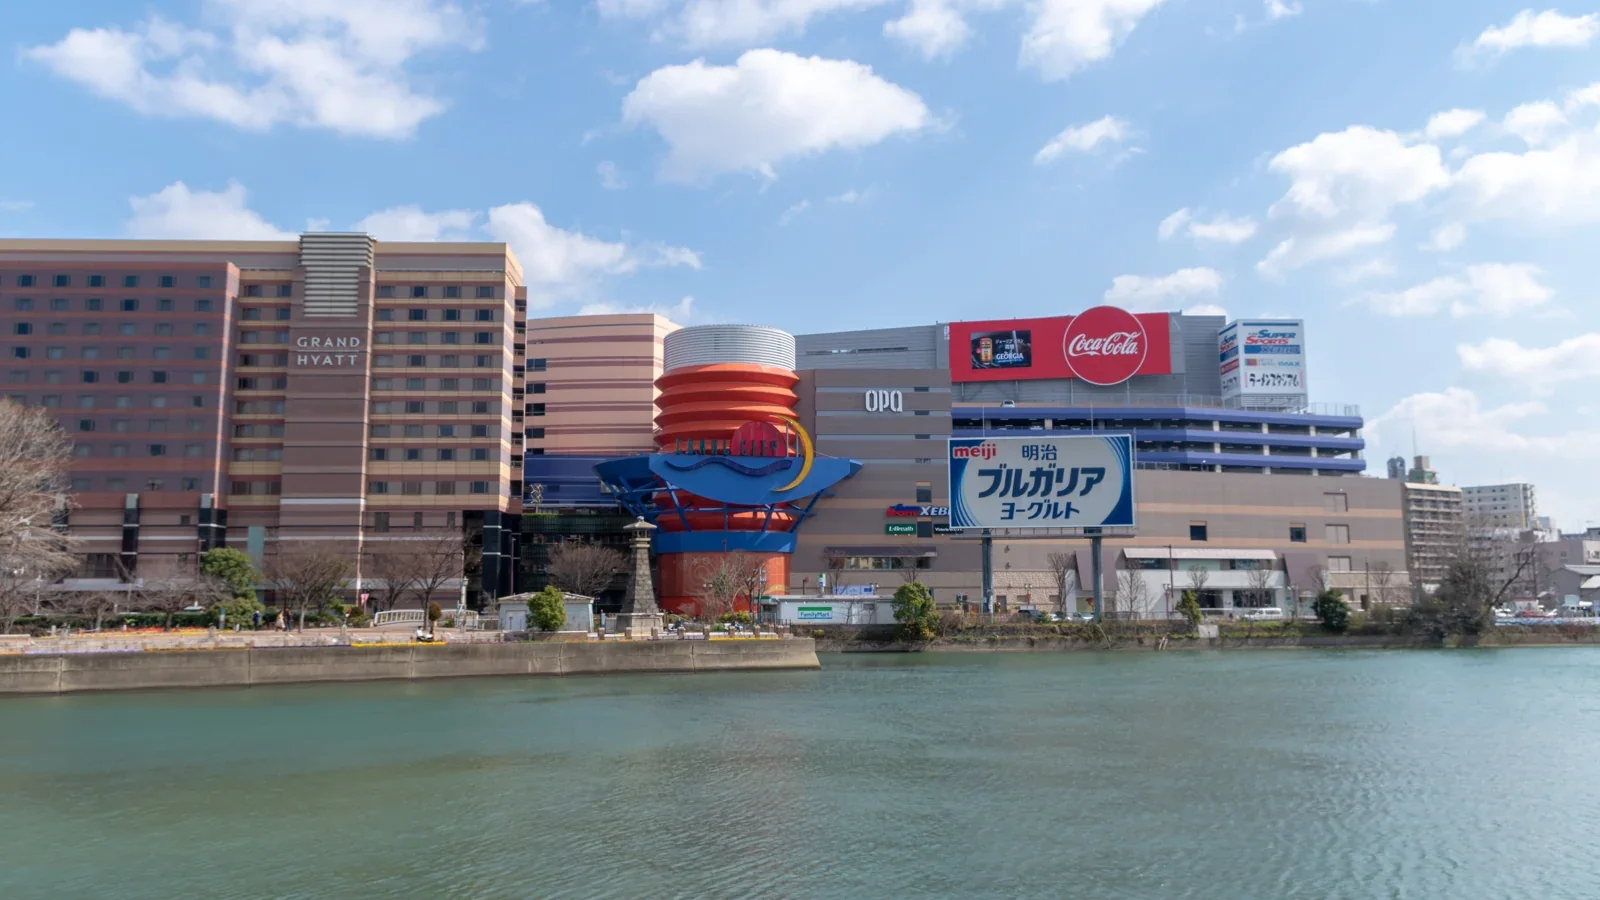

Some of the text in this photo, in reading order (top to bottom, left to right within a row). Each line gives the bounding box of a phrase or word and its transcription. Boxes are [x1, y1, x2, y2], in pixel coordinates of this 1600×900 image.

[297, 336, 360, 347] GRAND
[1068, 332, 1141, 356] Coca-Cola
[297, 355, 358, 366] HYATT
[865, 389, 903, 412] OPA
[953, 443, 997, 460] meiji
[1022, 444, 1058, 461] 明治
[978, 463, 1106, 498] ブルガリア
[920, 506, 950, 516] XEB
[1000, 499, 1080, 520] ヨーグルト
